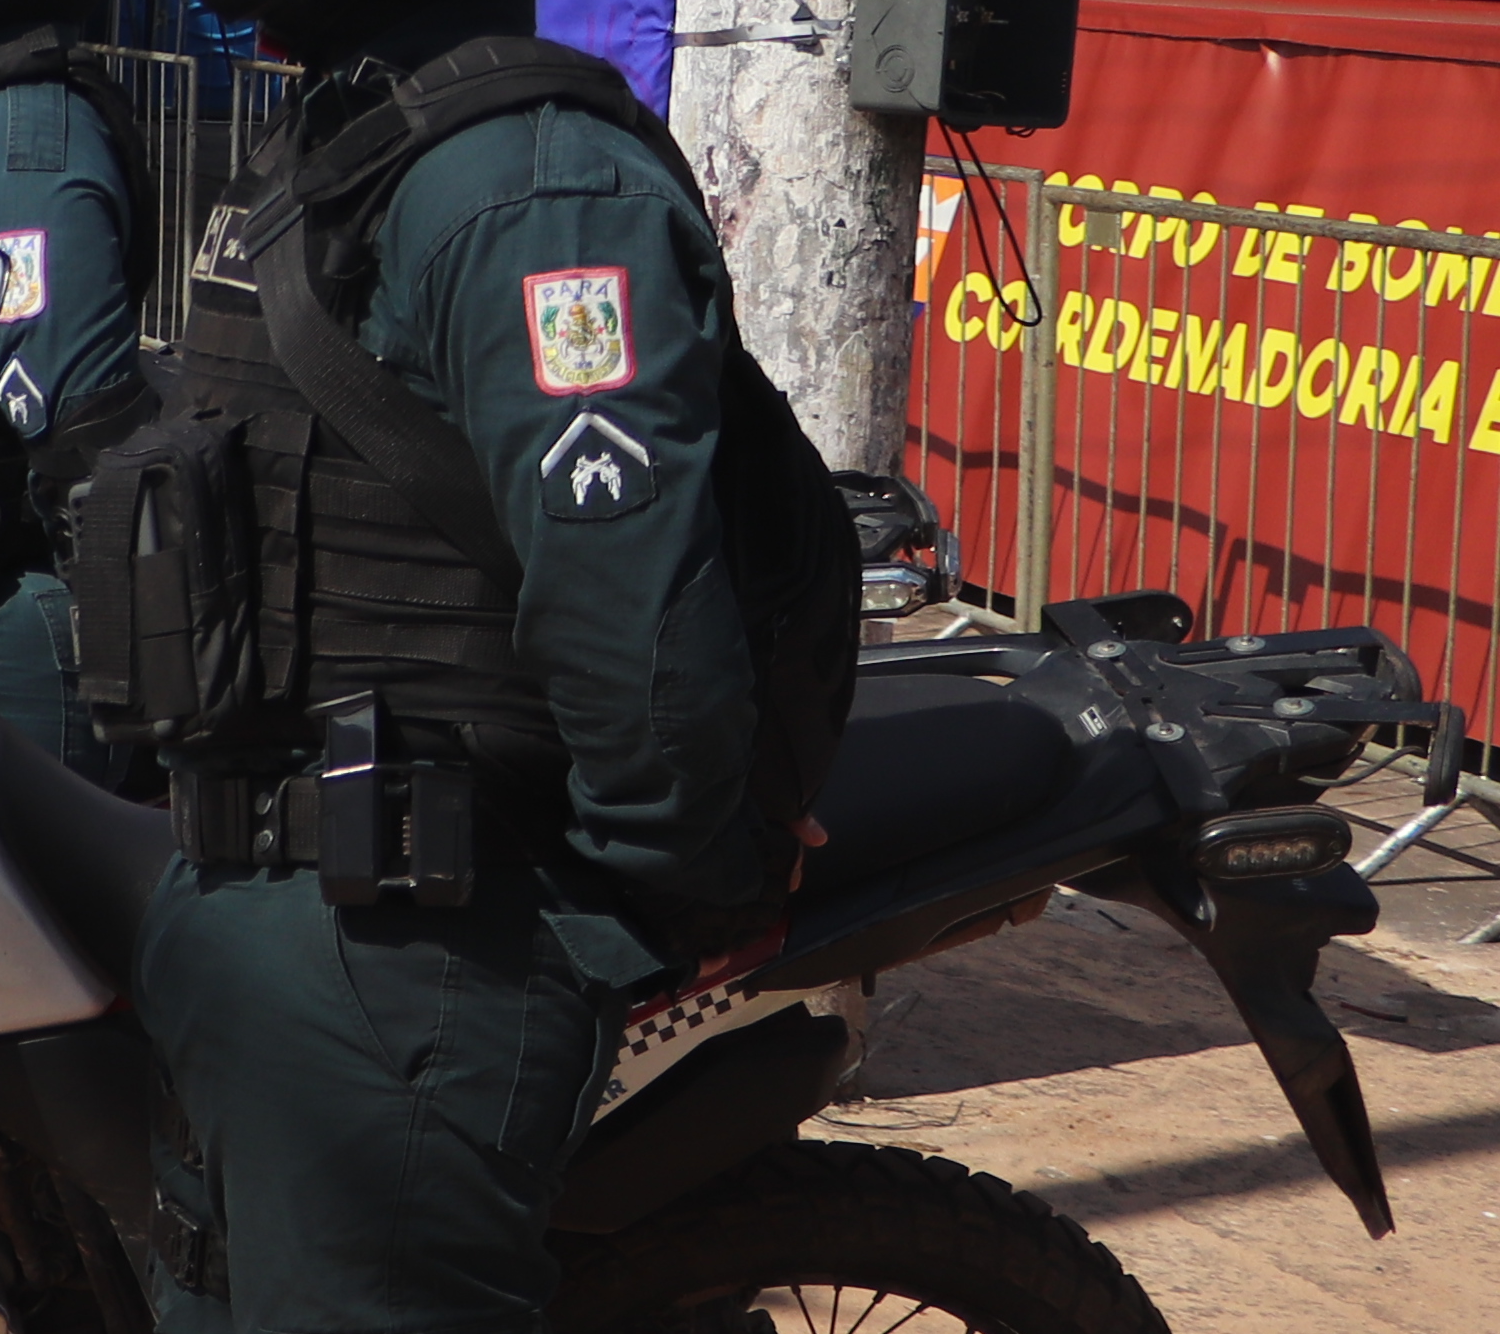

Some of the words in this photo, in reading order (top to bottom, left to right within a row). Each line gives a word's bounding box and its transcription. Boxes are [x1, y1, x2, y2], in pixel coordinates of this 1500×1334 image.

[1043, 171, 1222, 268] CORPO
[1233, 202, 1325, 285] DE
[542, 278, 613, 302] PARÁ
[945, 272, 1459, 444] CORDENADORIA
